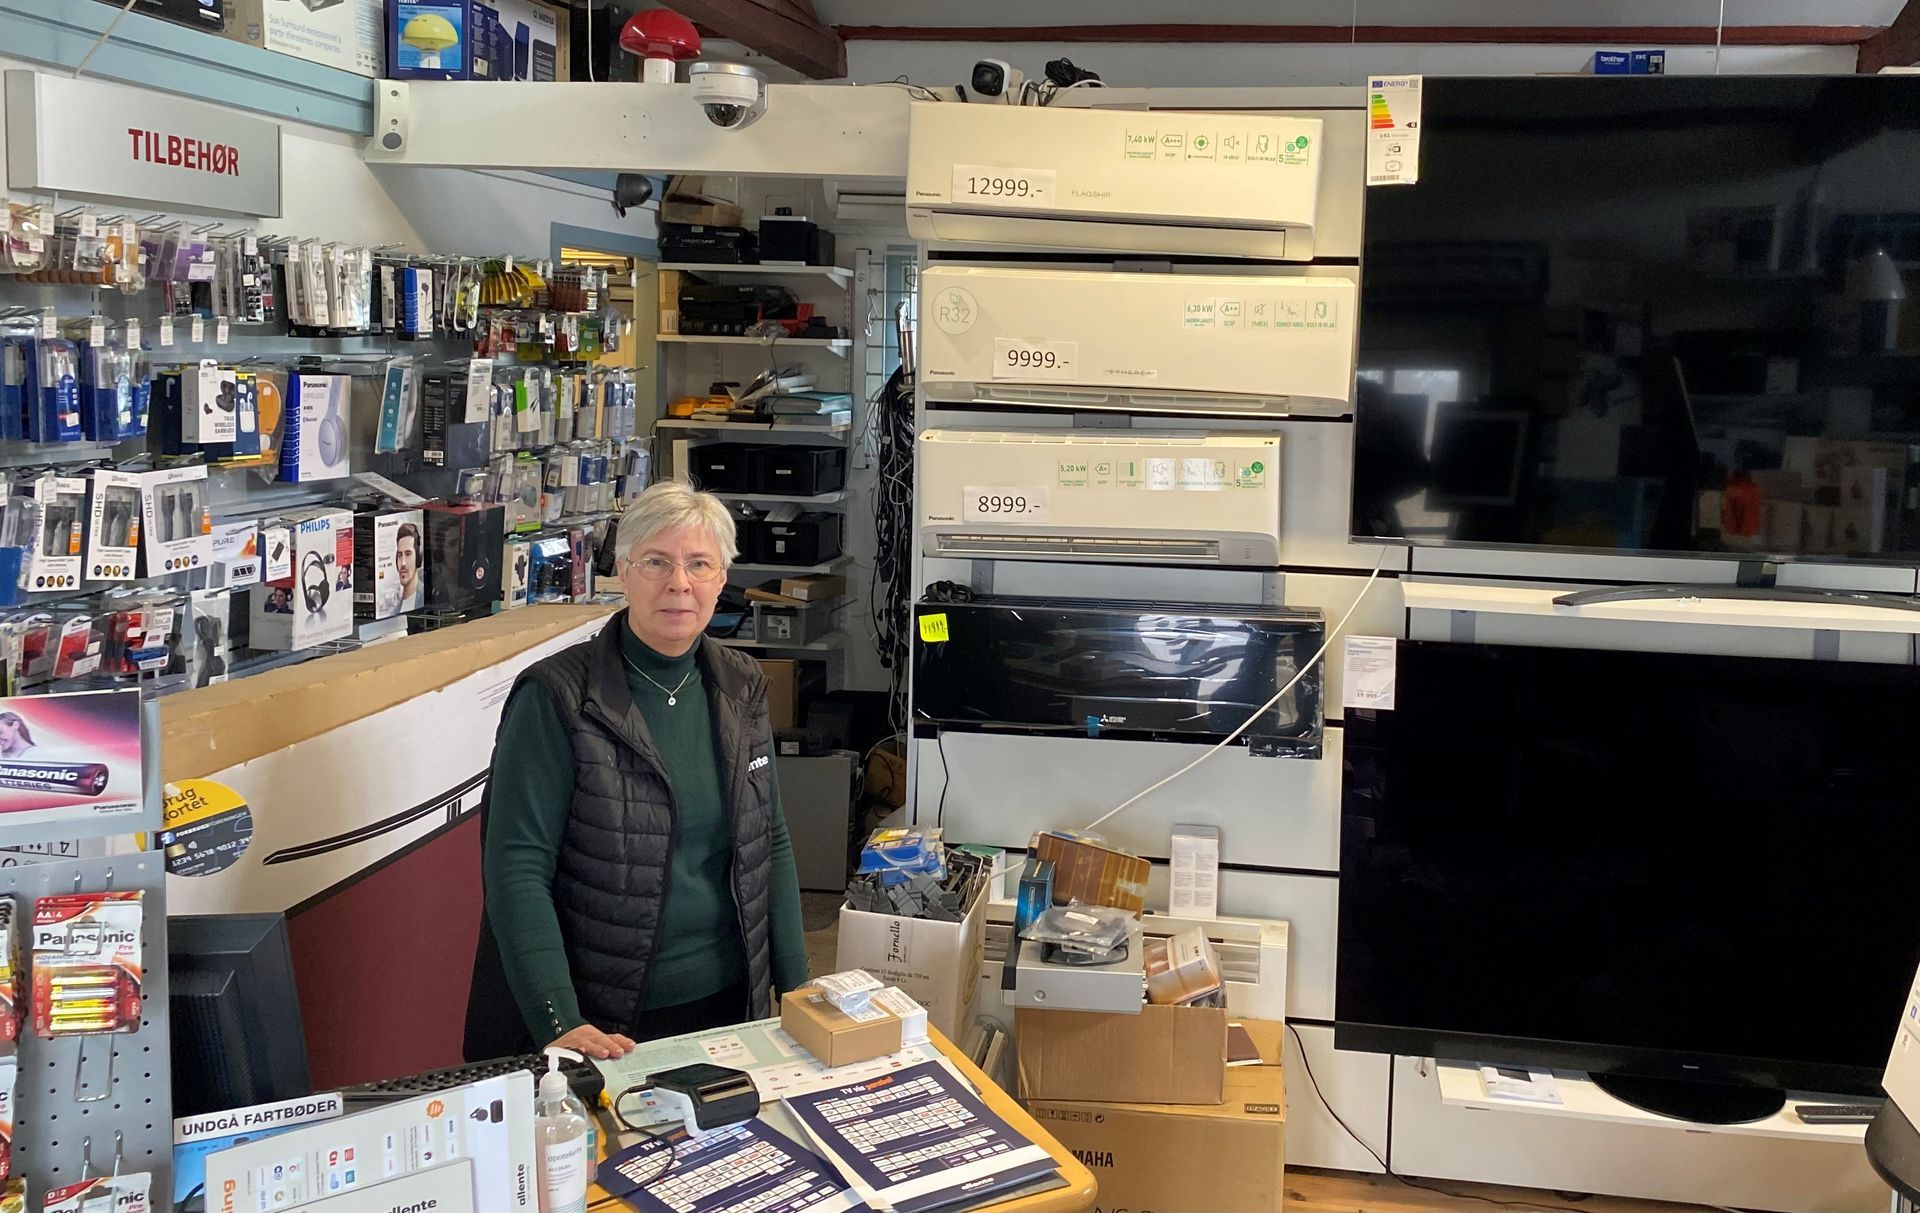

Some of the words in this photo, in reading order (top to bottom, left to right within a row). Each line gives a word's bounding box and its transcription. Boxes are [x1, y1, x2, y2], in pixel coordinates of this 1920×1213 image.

[1144, 135, 1155, 144] kW
[128, 128, 239, 176] TILBEHØR
[916, 190, 942, 198] Panasonic
[967, 176, 1043, 198] 12999.-
[1072, 190, 1111, 198] FLAGSHIP
[939, 306, 970, 324] R32
[1007, 349, 1070, 369] 9999.-
[94, 493, 104, 518] SHD
[144, 494, 153, 518] SHD
[978, 496, 1040, 512] 8999.-
[300, 519, 330, 534] PHILIPS
[378, 520, 398, 528] Panasonic
[213, 537, 235, 546] PURE
[840, 1087, 853, 1096] TV
[854, 1084, 866, 1093] via
[182, 1114, 240, 1136] UNDGÅ
[244, 1100, 338, 1126] FARTBØDER
[641, 1142, 655, 1150] TV
[517, 1164, 526, 1206] allente
[961, 1177, 995, 1191] allente
